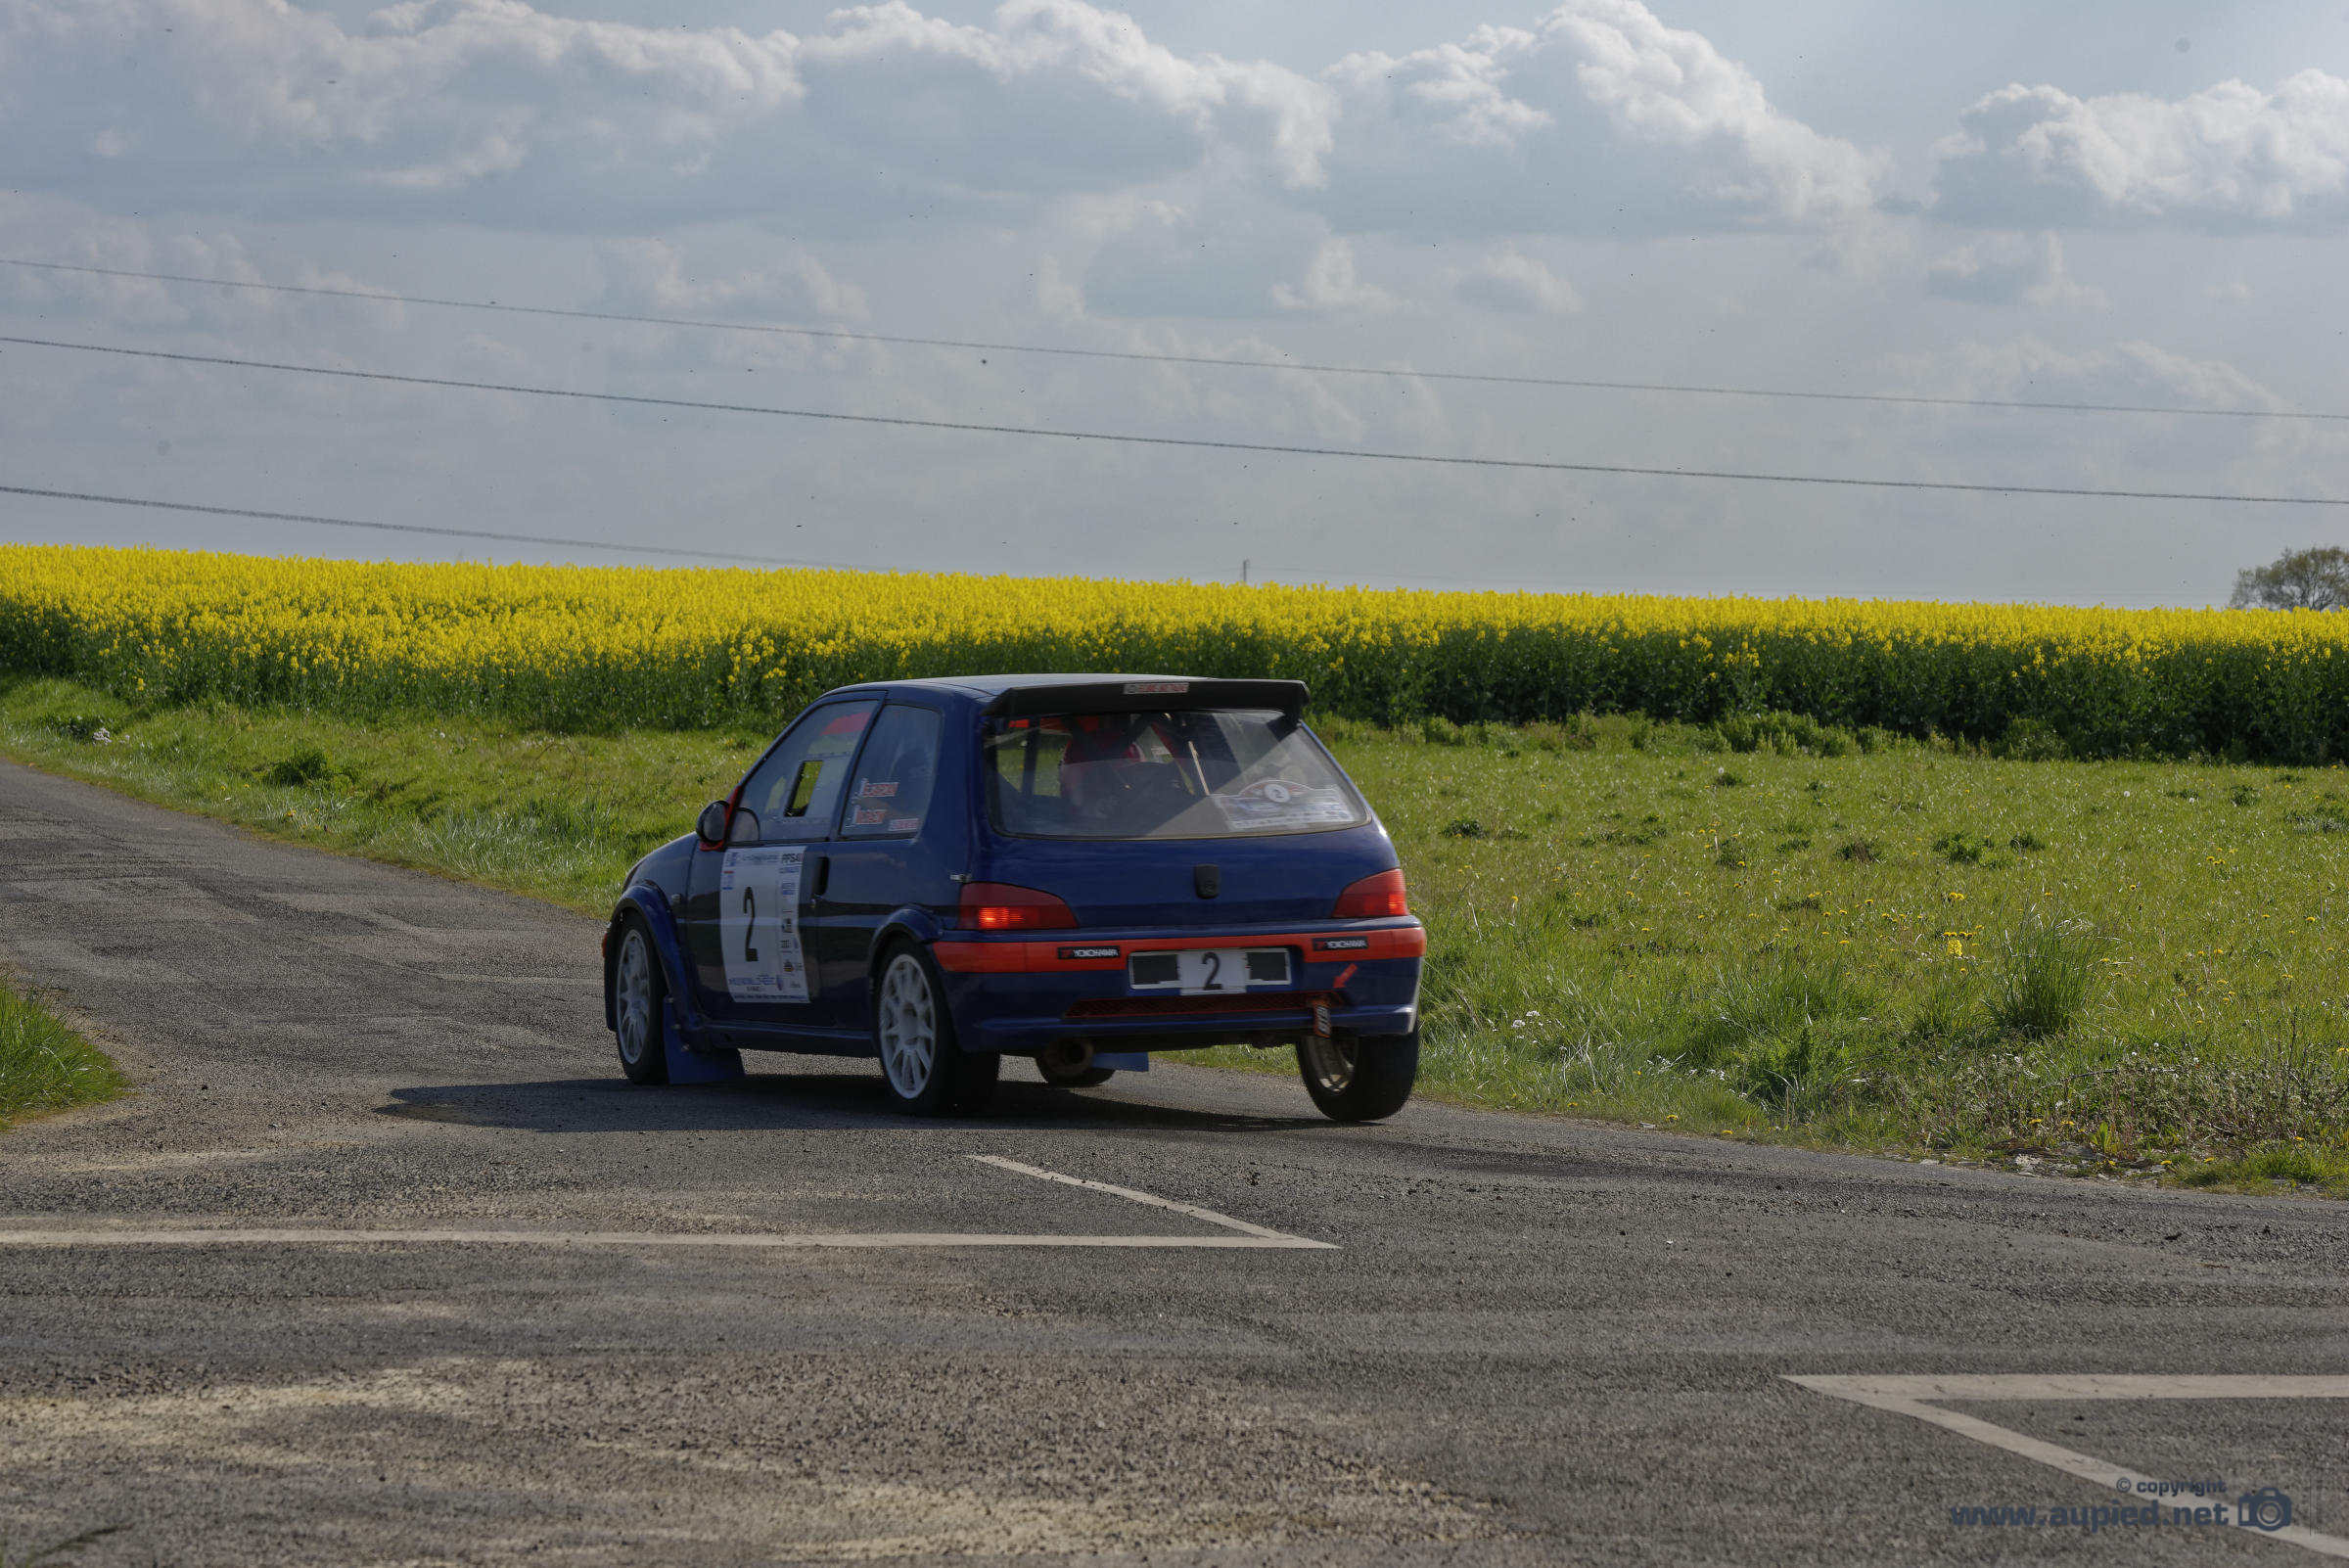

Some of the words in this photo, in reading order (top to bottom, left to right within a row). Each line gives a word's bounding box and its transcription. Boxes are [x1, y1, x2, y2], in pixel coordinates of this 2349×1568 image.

[743, 886, 759, 962] 2
[1073, 948, 1119, 957] YOKOHAMA
[1202, 951, 1223, 991] 2
